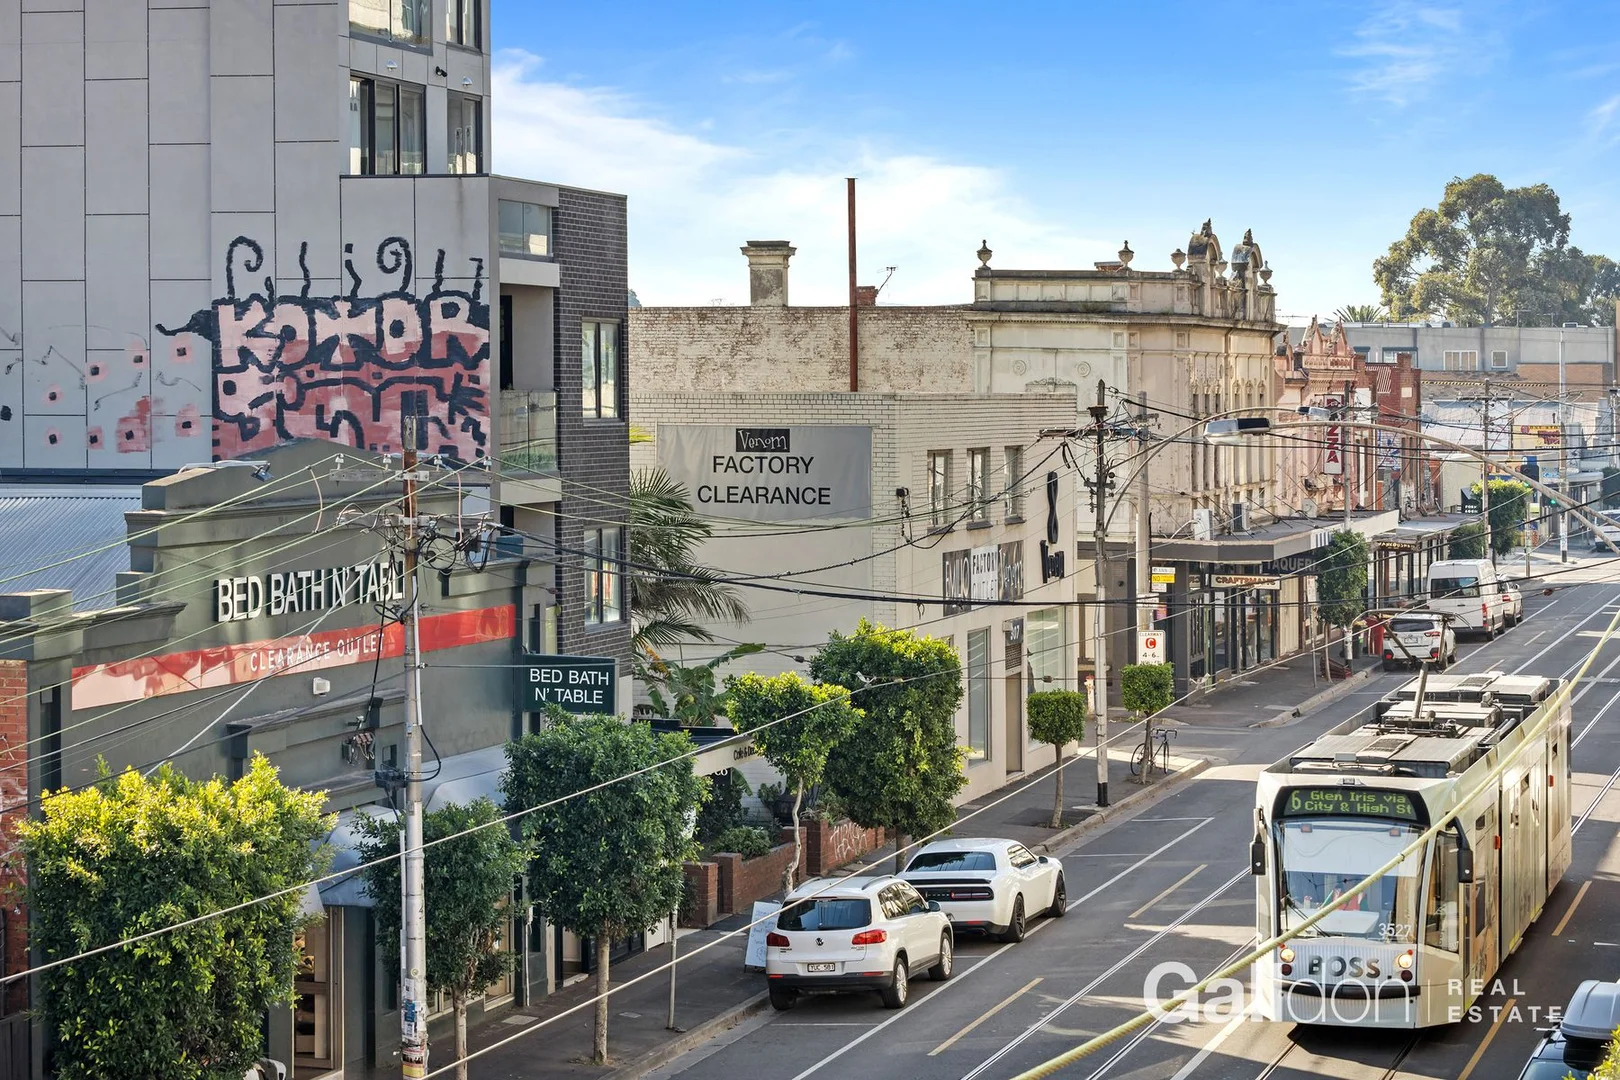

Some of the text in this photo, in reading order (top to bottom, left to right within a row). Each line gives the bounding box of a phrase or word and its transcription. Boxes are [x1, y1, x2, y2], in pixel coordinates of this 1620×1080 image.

[738, 429, 788, 450] Venom
[1326, 398, 1340, 464] PZZA
[712, 455, 815, 474] FACTORY
[697, 485, 831, 505] CLEARANCE
[1266, 557, 1318, 572] TAQUERI
[218, 575, 263, 622] BED
[271, 569, 325, 616] BATH
[355, 560, 405, 604] TABL
[250, 633, 385, 672] CLEARANCE OUTLET
[530, 668, 609, 685] BED BATH
[535, 687, 603, 704] N' TABLE
[1291, 790, 1301, 812] 6
[1310, 790, 1406, 804] Glen Iris via
[1304, 801, 1412, 815] City & High St
[1378, 922, 1412, 937] 3527
[1308, 955, 1380, 979] BOSS
